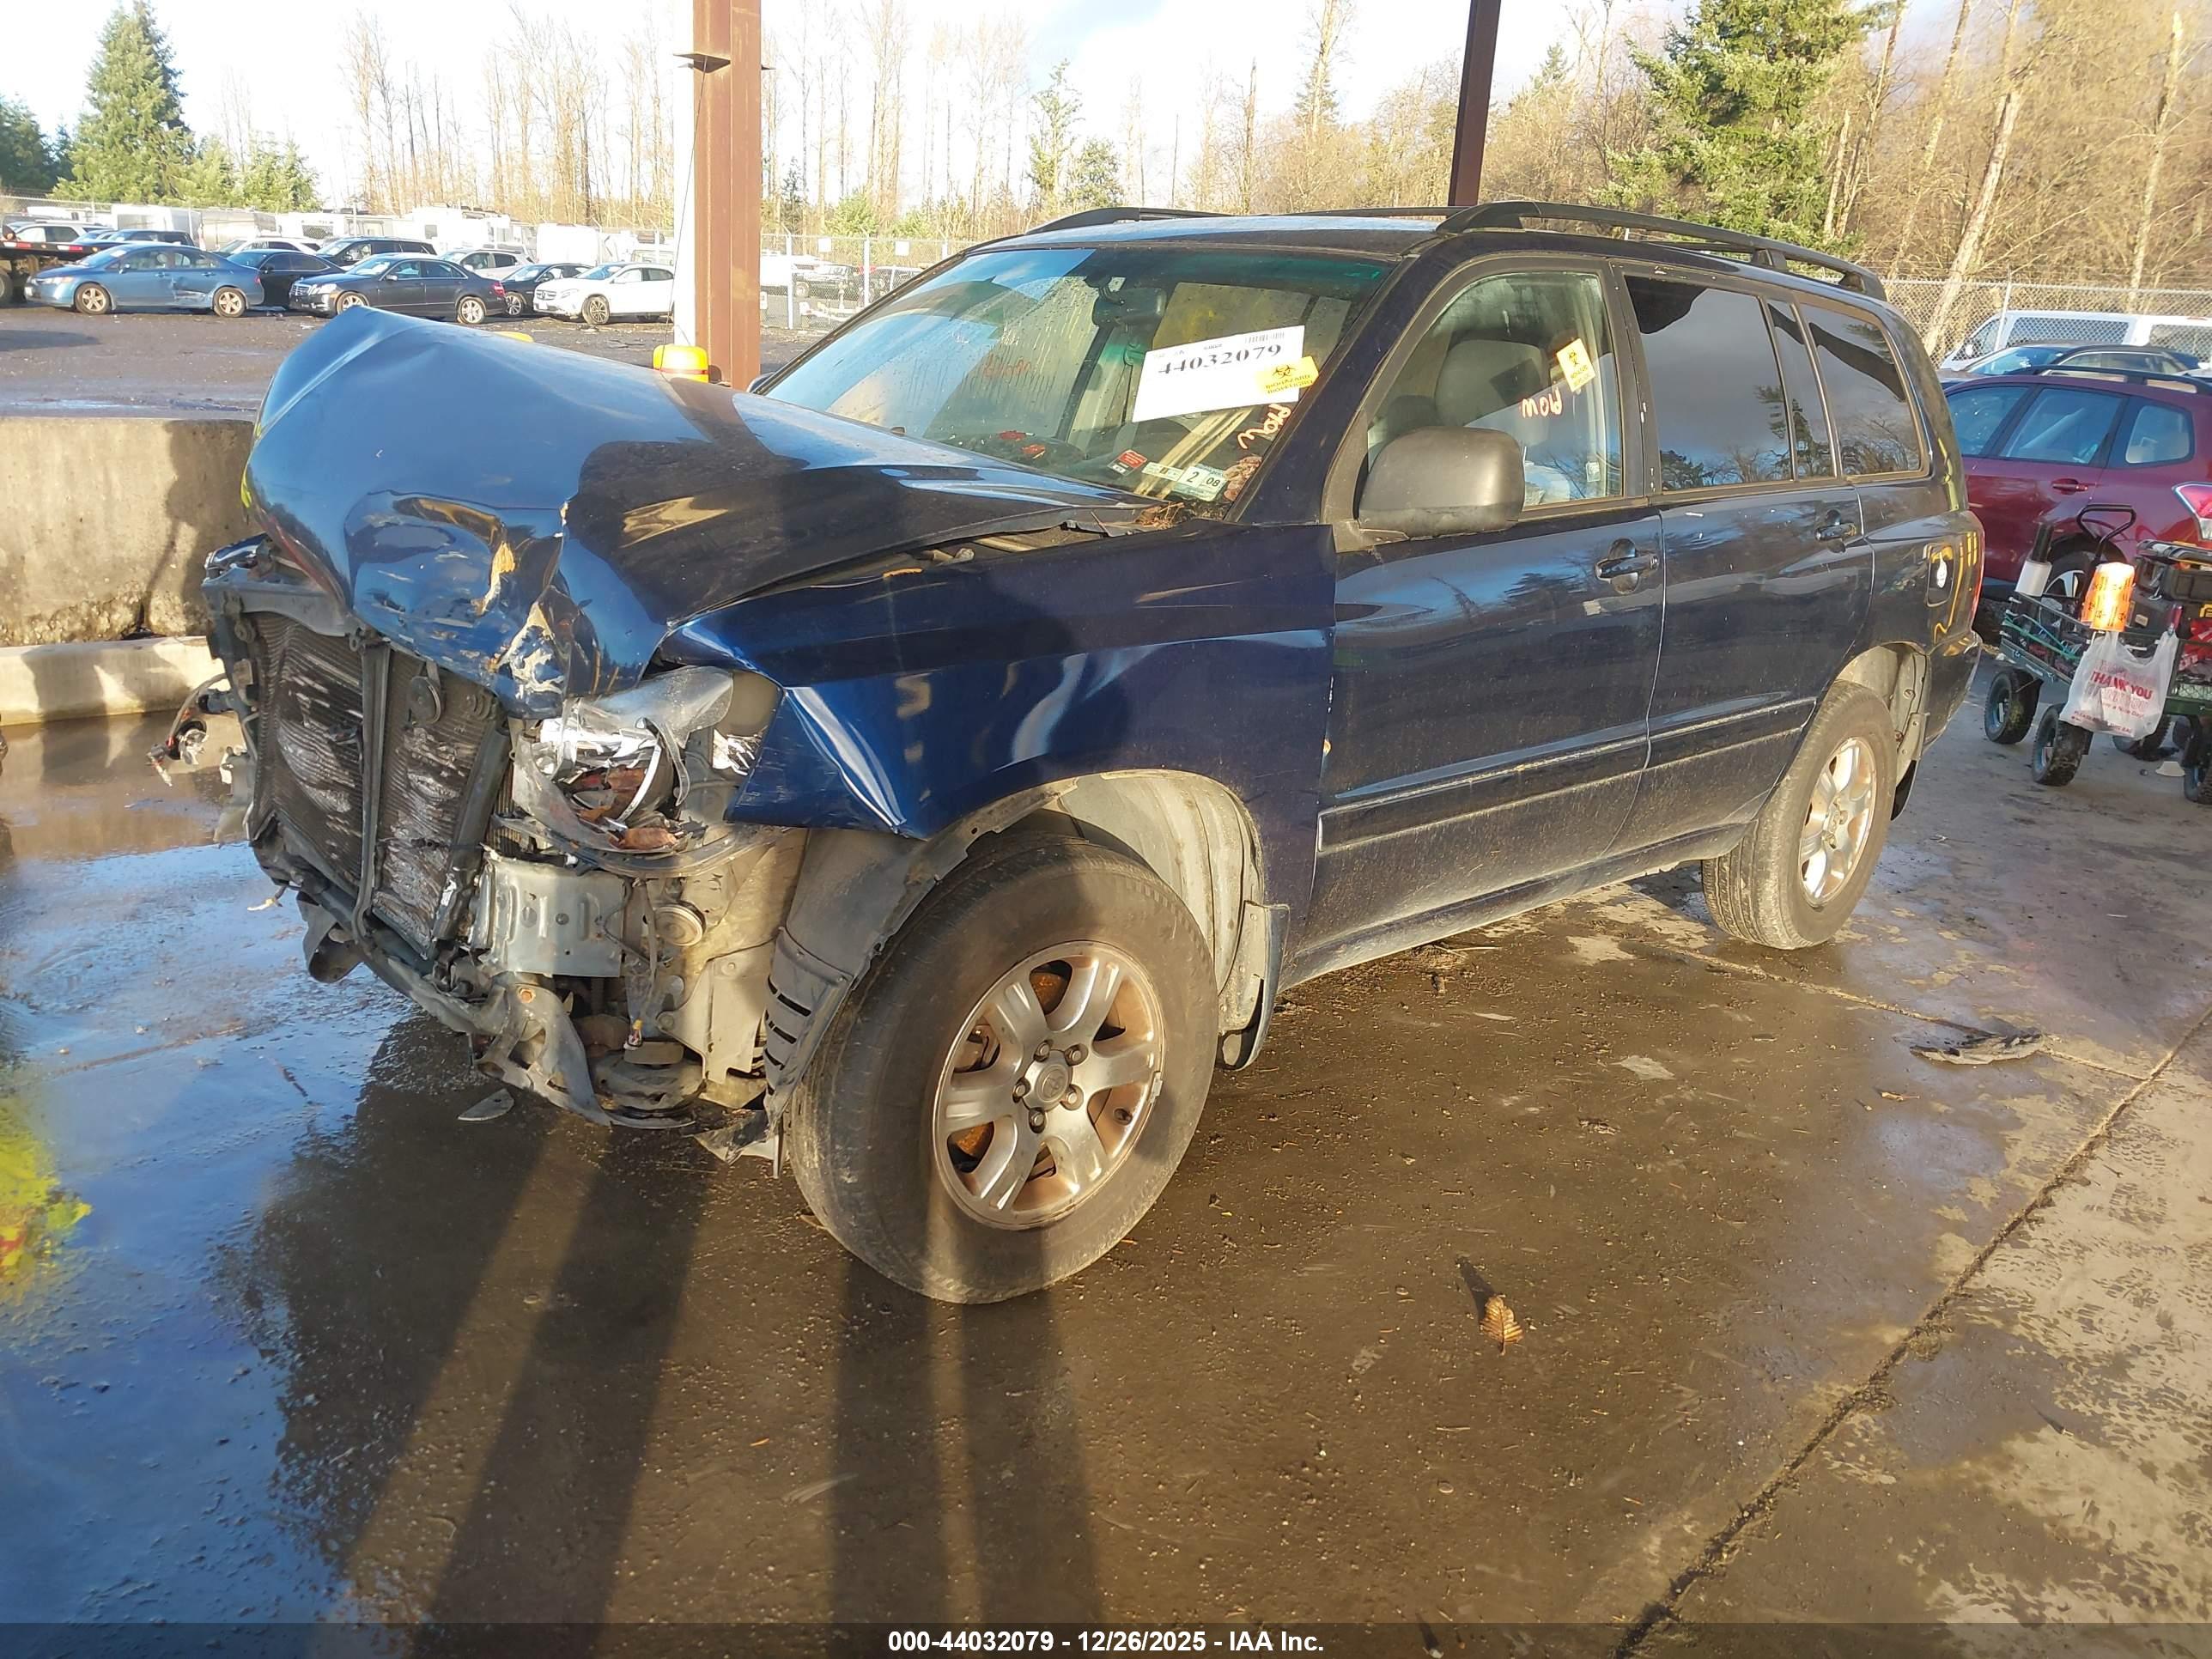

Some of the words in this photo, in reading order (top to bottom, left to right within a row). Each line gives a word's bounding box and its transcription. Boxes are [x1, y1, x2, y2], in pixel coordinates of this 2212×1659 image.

[1158, 344, 1282, 374] 44032079
[1187, 471, 1200, 483] 2
[1206, 477, 1221, 487] 08
[2091, 671, 2128, 690] THANK
[2130, 684, 2153, 700] YOU
